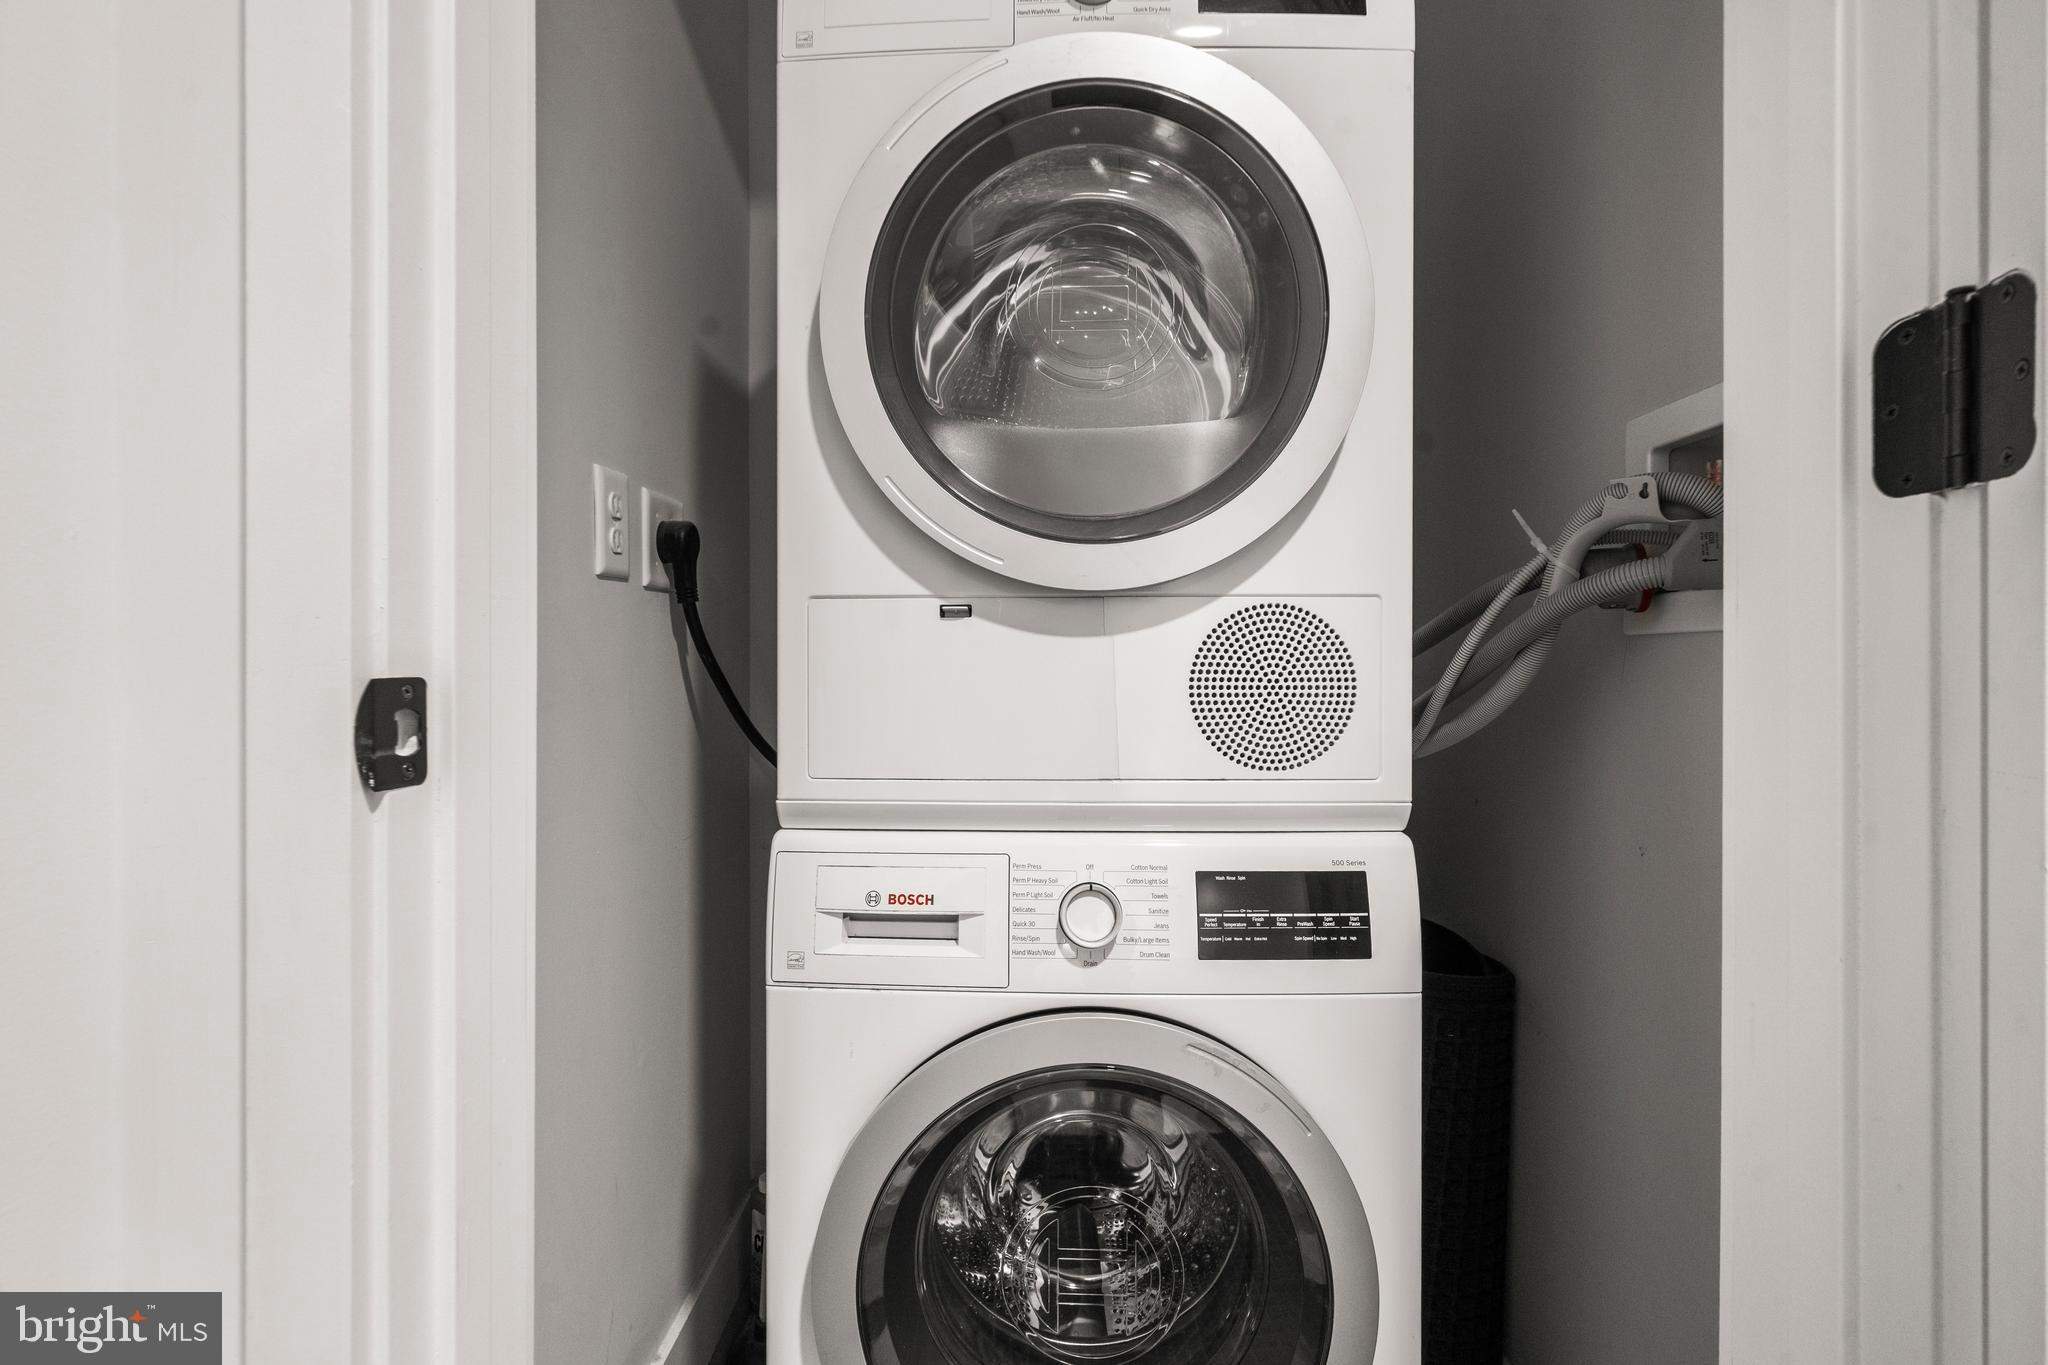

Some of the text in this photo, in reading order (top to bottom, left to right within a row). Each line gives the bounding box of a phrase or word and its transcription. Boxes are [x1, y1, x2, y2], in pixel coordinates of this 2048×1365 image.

[1145, 878, 1158, 886] Light
[888, 893, 934, 906] BOSCH
[1123, 936, 1154, 944] Bulky/Large
